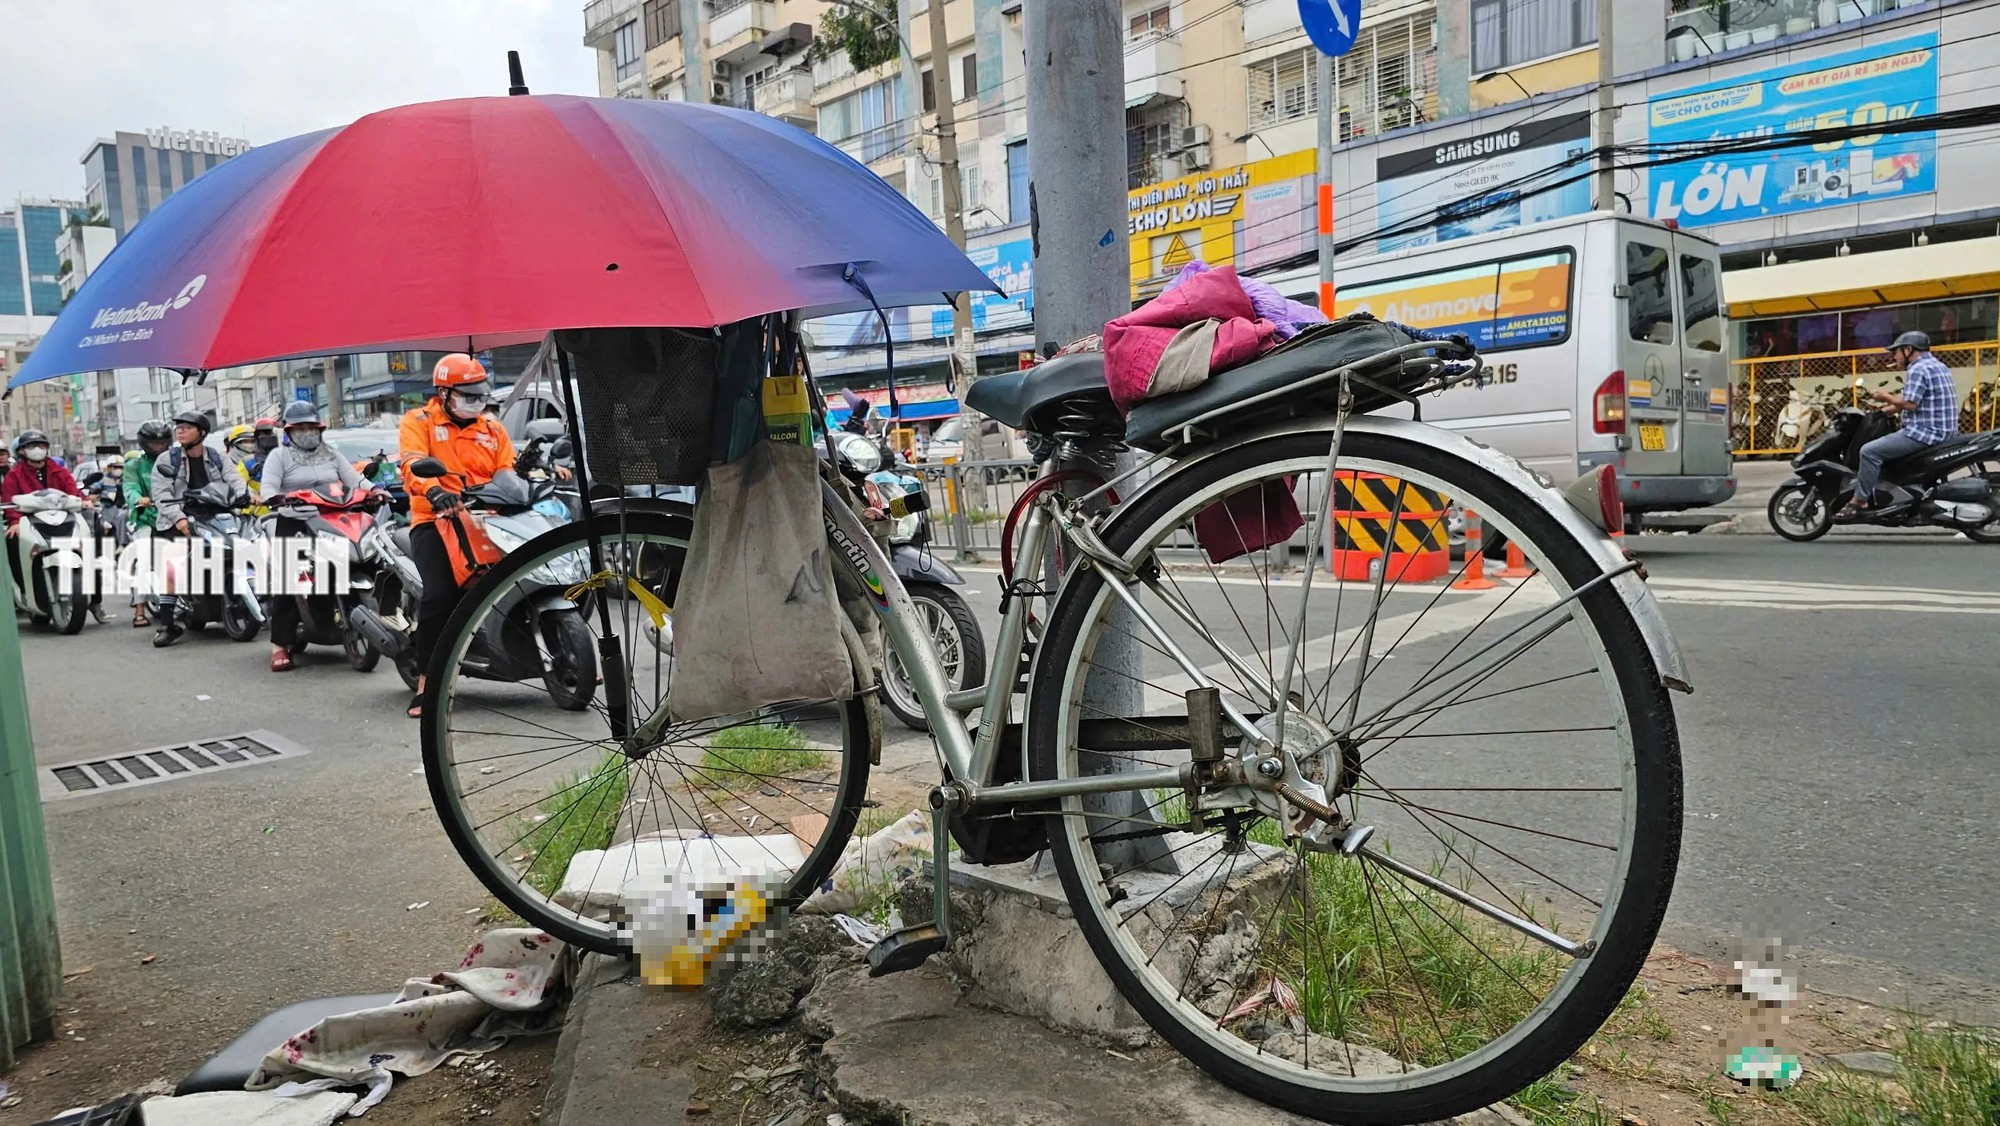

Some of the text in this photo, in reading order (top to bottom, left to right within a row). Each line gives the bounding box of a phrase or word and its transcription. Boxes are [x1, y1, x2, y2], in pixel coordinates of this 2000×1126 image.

[1874, 61, 1888, 73] 30
[1435, 131, 1521, 164] SAMSUNG
[1166, 182, 1189, 201] MÁY
[1221, 167, 1249, 189] THẤT
[1453, 180, 1470, 190] Neo
[1653, 161, 1768, 221] LỚN
[1135, 199, 1212, 232] CHỢ LỚN
[1383, 292, 1501, 323] Ahamove
[769, 432, 798, 441] FALCON
